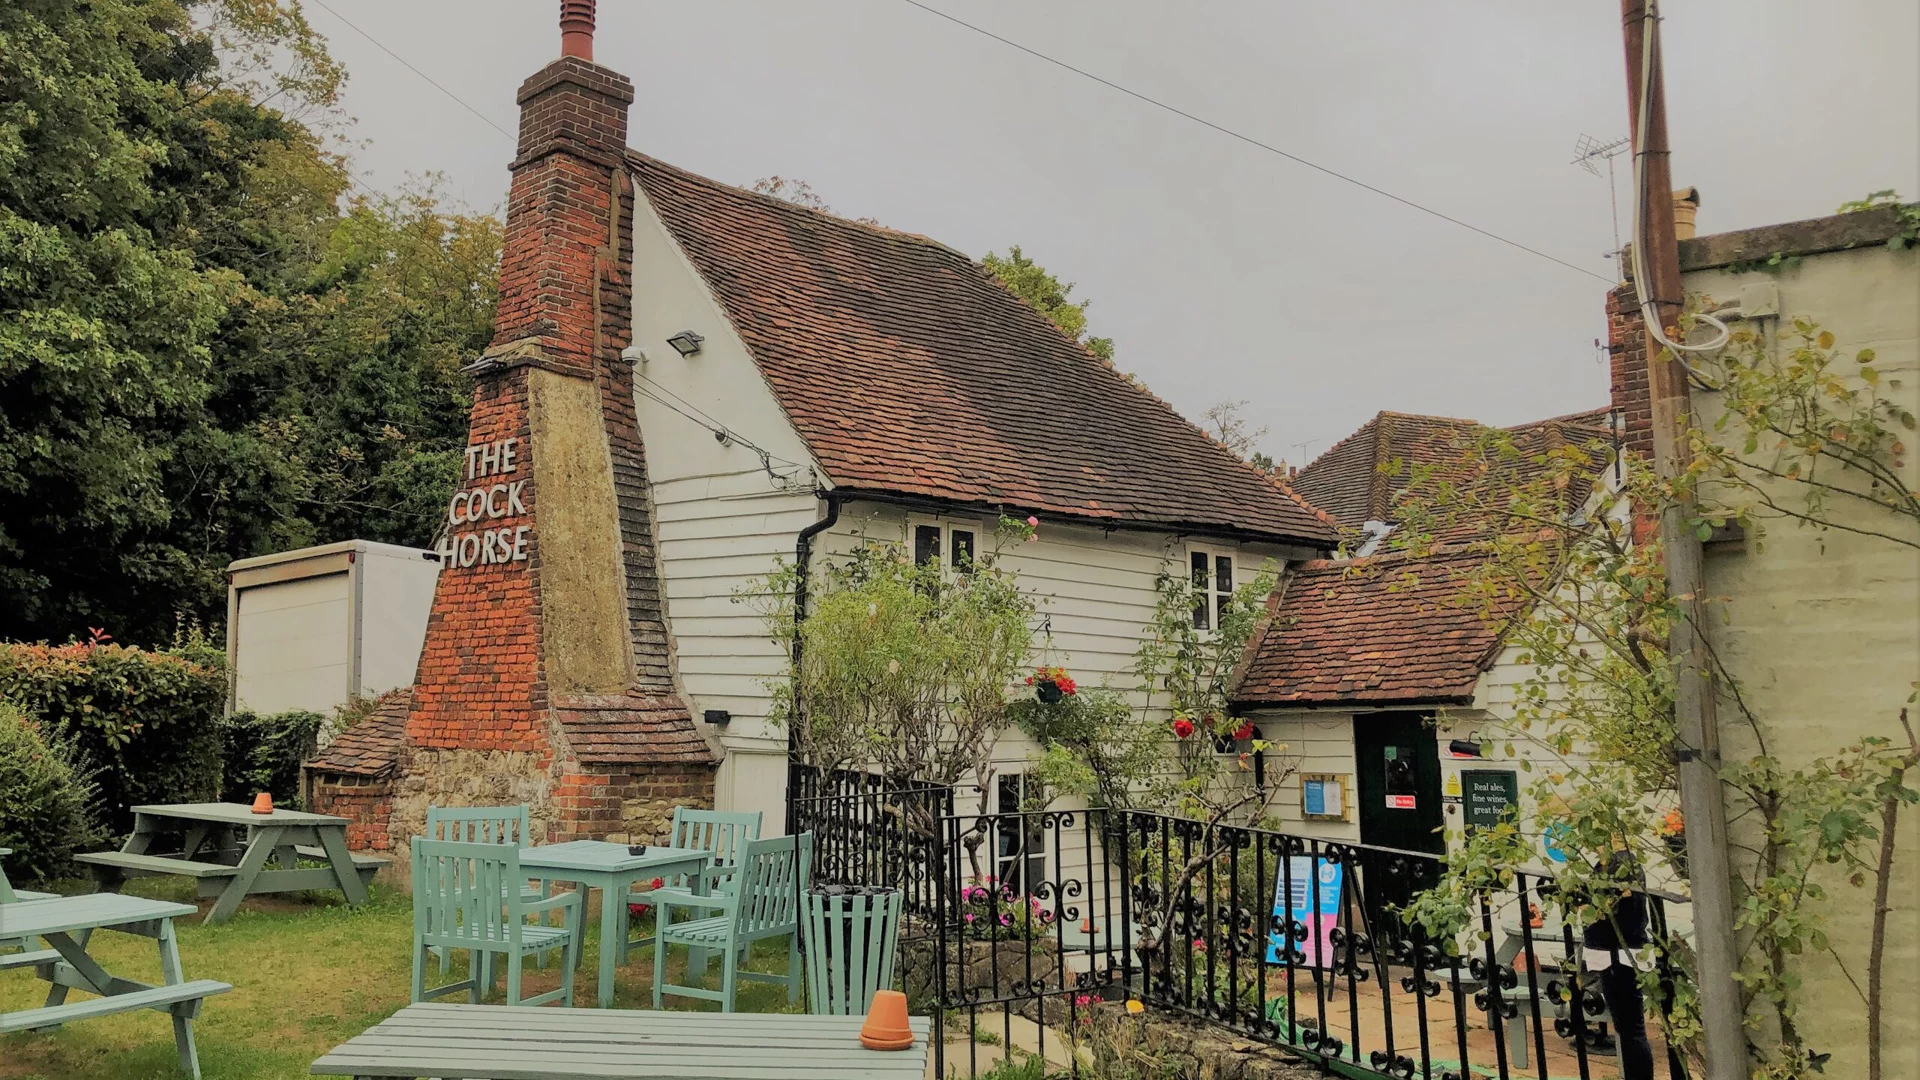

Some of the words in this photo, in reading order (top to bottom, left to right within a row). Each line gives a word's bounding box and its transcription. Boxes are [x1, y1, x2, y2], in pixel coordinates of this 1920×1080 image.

[465, 437, 517, 480] THE
[449, 480, 528, 525] COCK
[439, 525, 530, 570] HORSE
[1474, 783, 1489, 791] Real
[1490, 783, 1506, 793] ales,
[1472, 794, 1485, 803] fine
[1486, 795, 1509, 804] wines,
[1474, 806, 1491, 816] great
[1492, 806, 1504, 815] foo
[1475, 823, 1490, 833] Find
